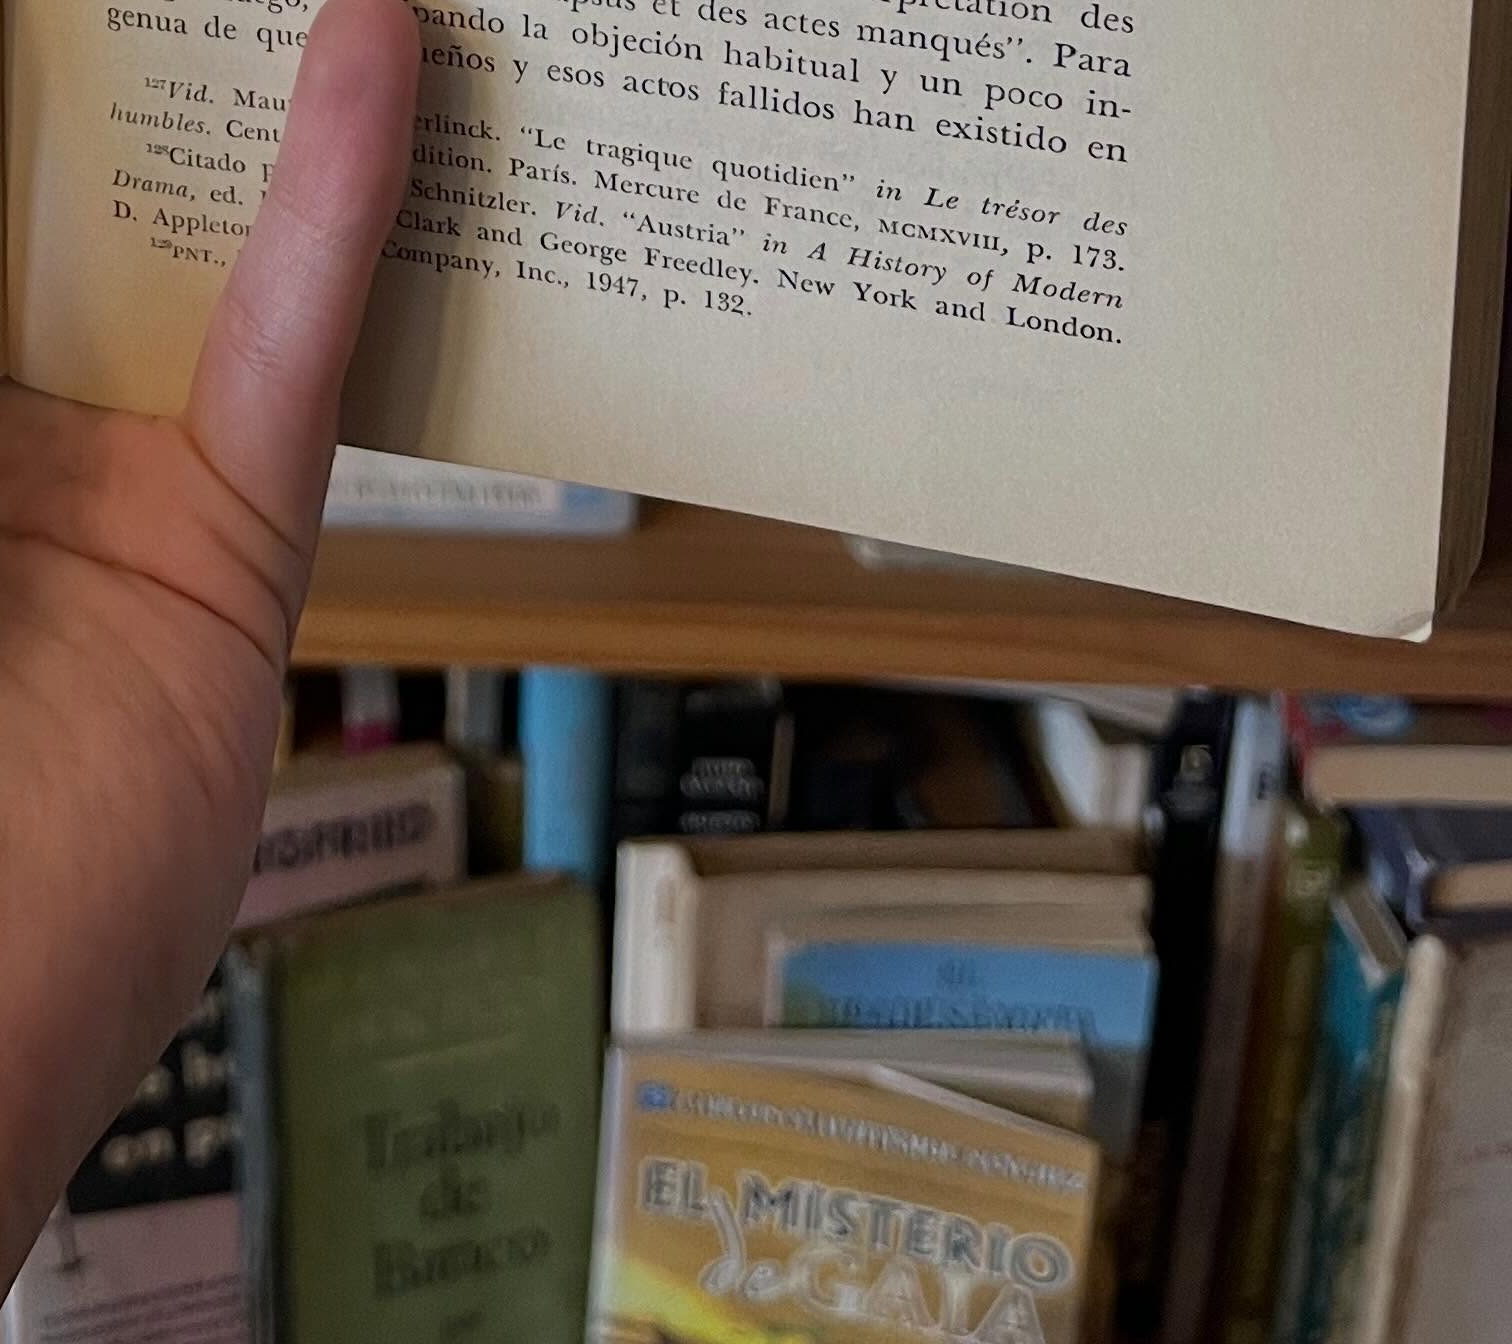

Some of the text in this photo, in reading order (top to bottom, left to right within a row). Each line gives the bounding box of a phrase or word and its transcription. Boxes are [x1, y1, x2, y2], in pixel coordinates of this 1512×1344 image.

[764, 12, 840, 38] actes
[1052, 42, 1132, 78] Para
[586, 138, 693, 173] tragique
[876, 178, 903, 202] in
[923, 186, 960, 210] Le
[981, 197, 1061, 225] trésor
[1082, 211, 1128, 236] des
[112, 199, 138, 222] D.
[516, 259, 569, 289] Inc.,
[587, 271, 647, 302] 1947,
[663, 288, 686, 310] p.
[704, 290, 752, 316] 132.
[639, 1156, 1075, 1289] EL MISTERIO
